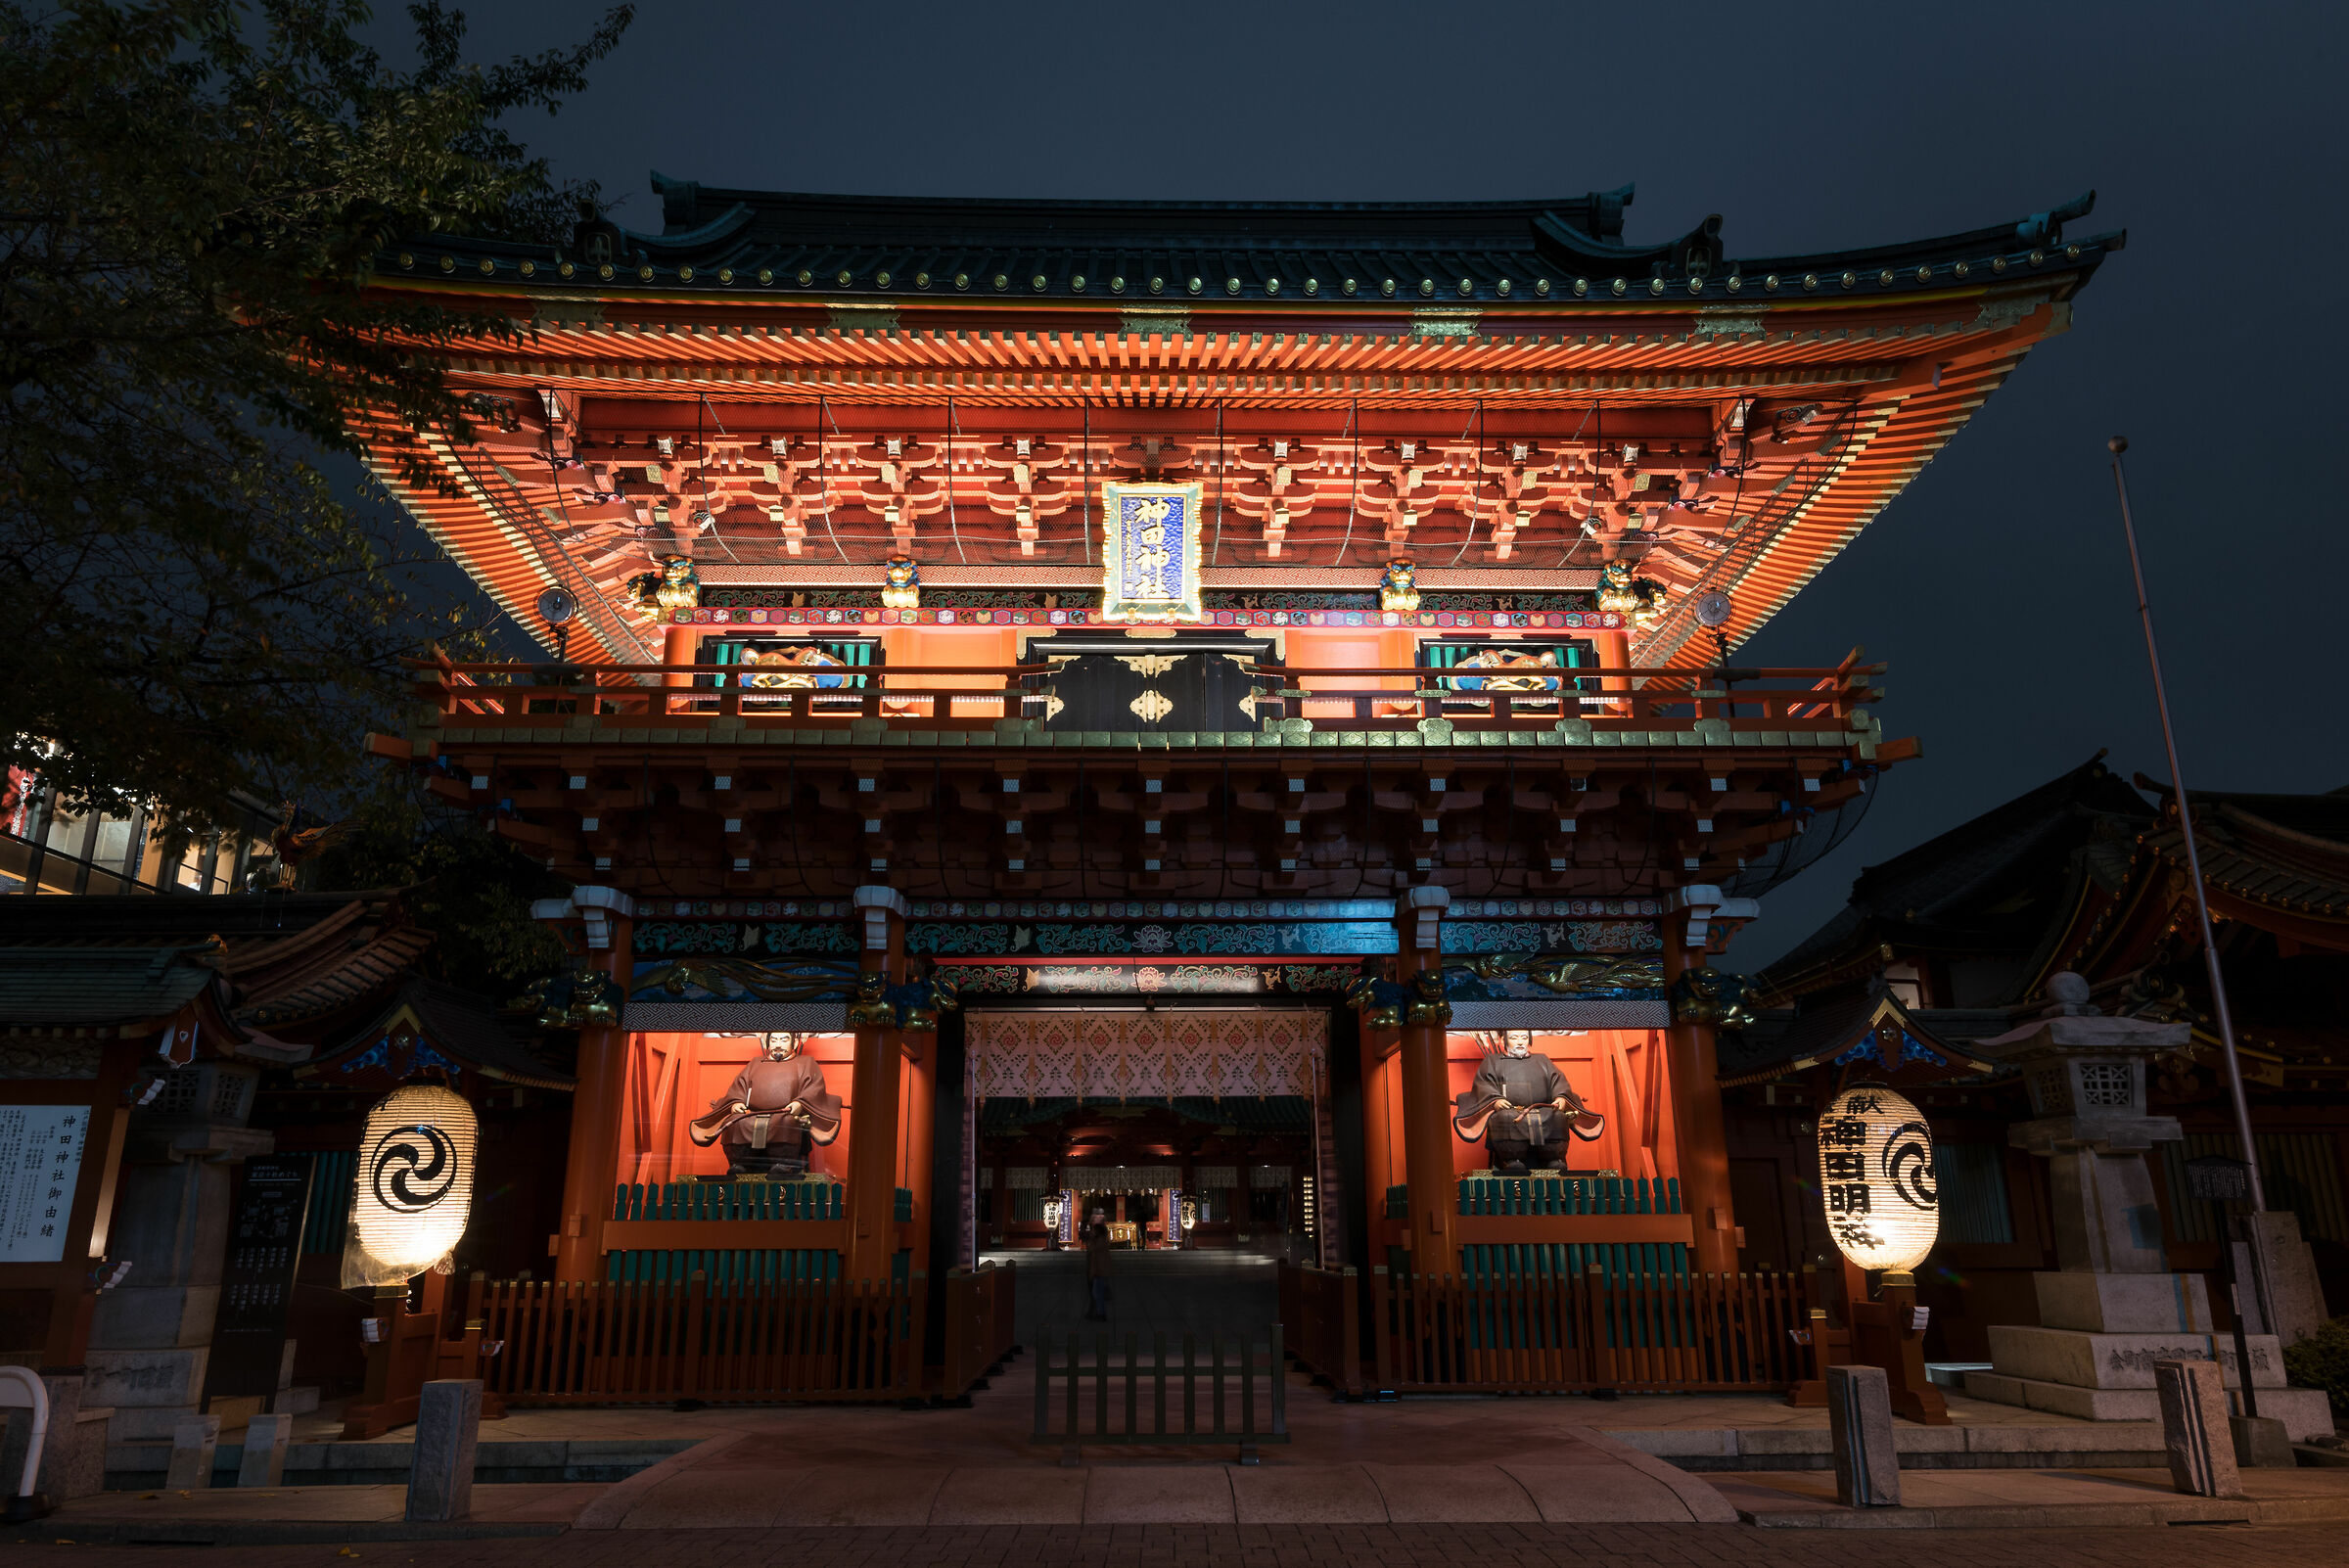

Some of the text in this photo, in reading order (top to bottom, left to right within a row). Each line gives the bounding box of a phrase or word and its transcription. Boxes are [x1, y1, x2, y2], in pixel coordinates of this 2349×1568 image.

[1134, 497, 1171, 599] 神田神社
[40, 1115, 76, 1238] 神田神社御由緒
[1820, 1116, 1885, 1250] 神田明神
